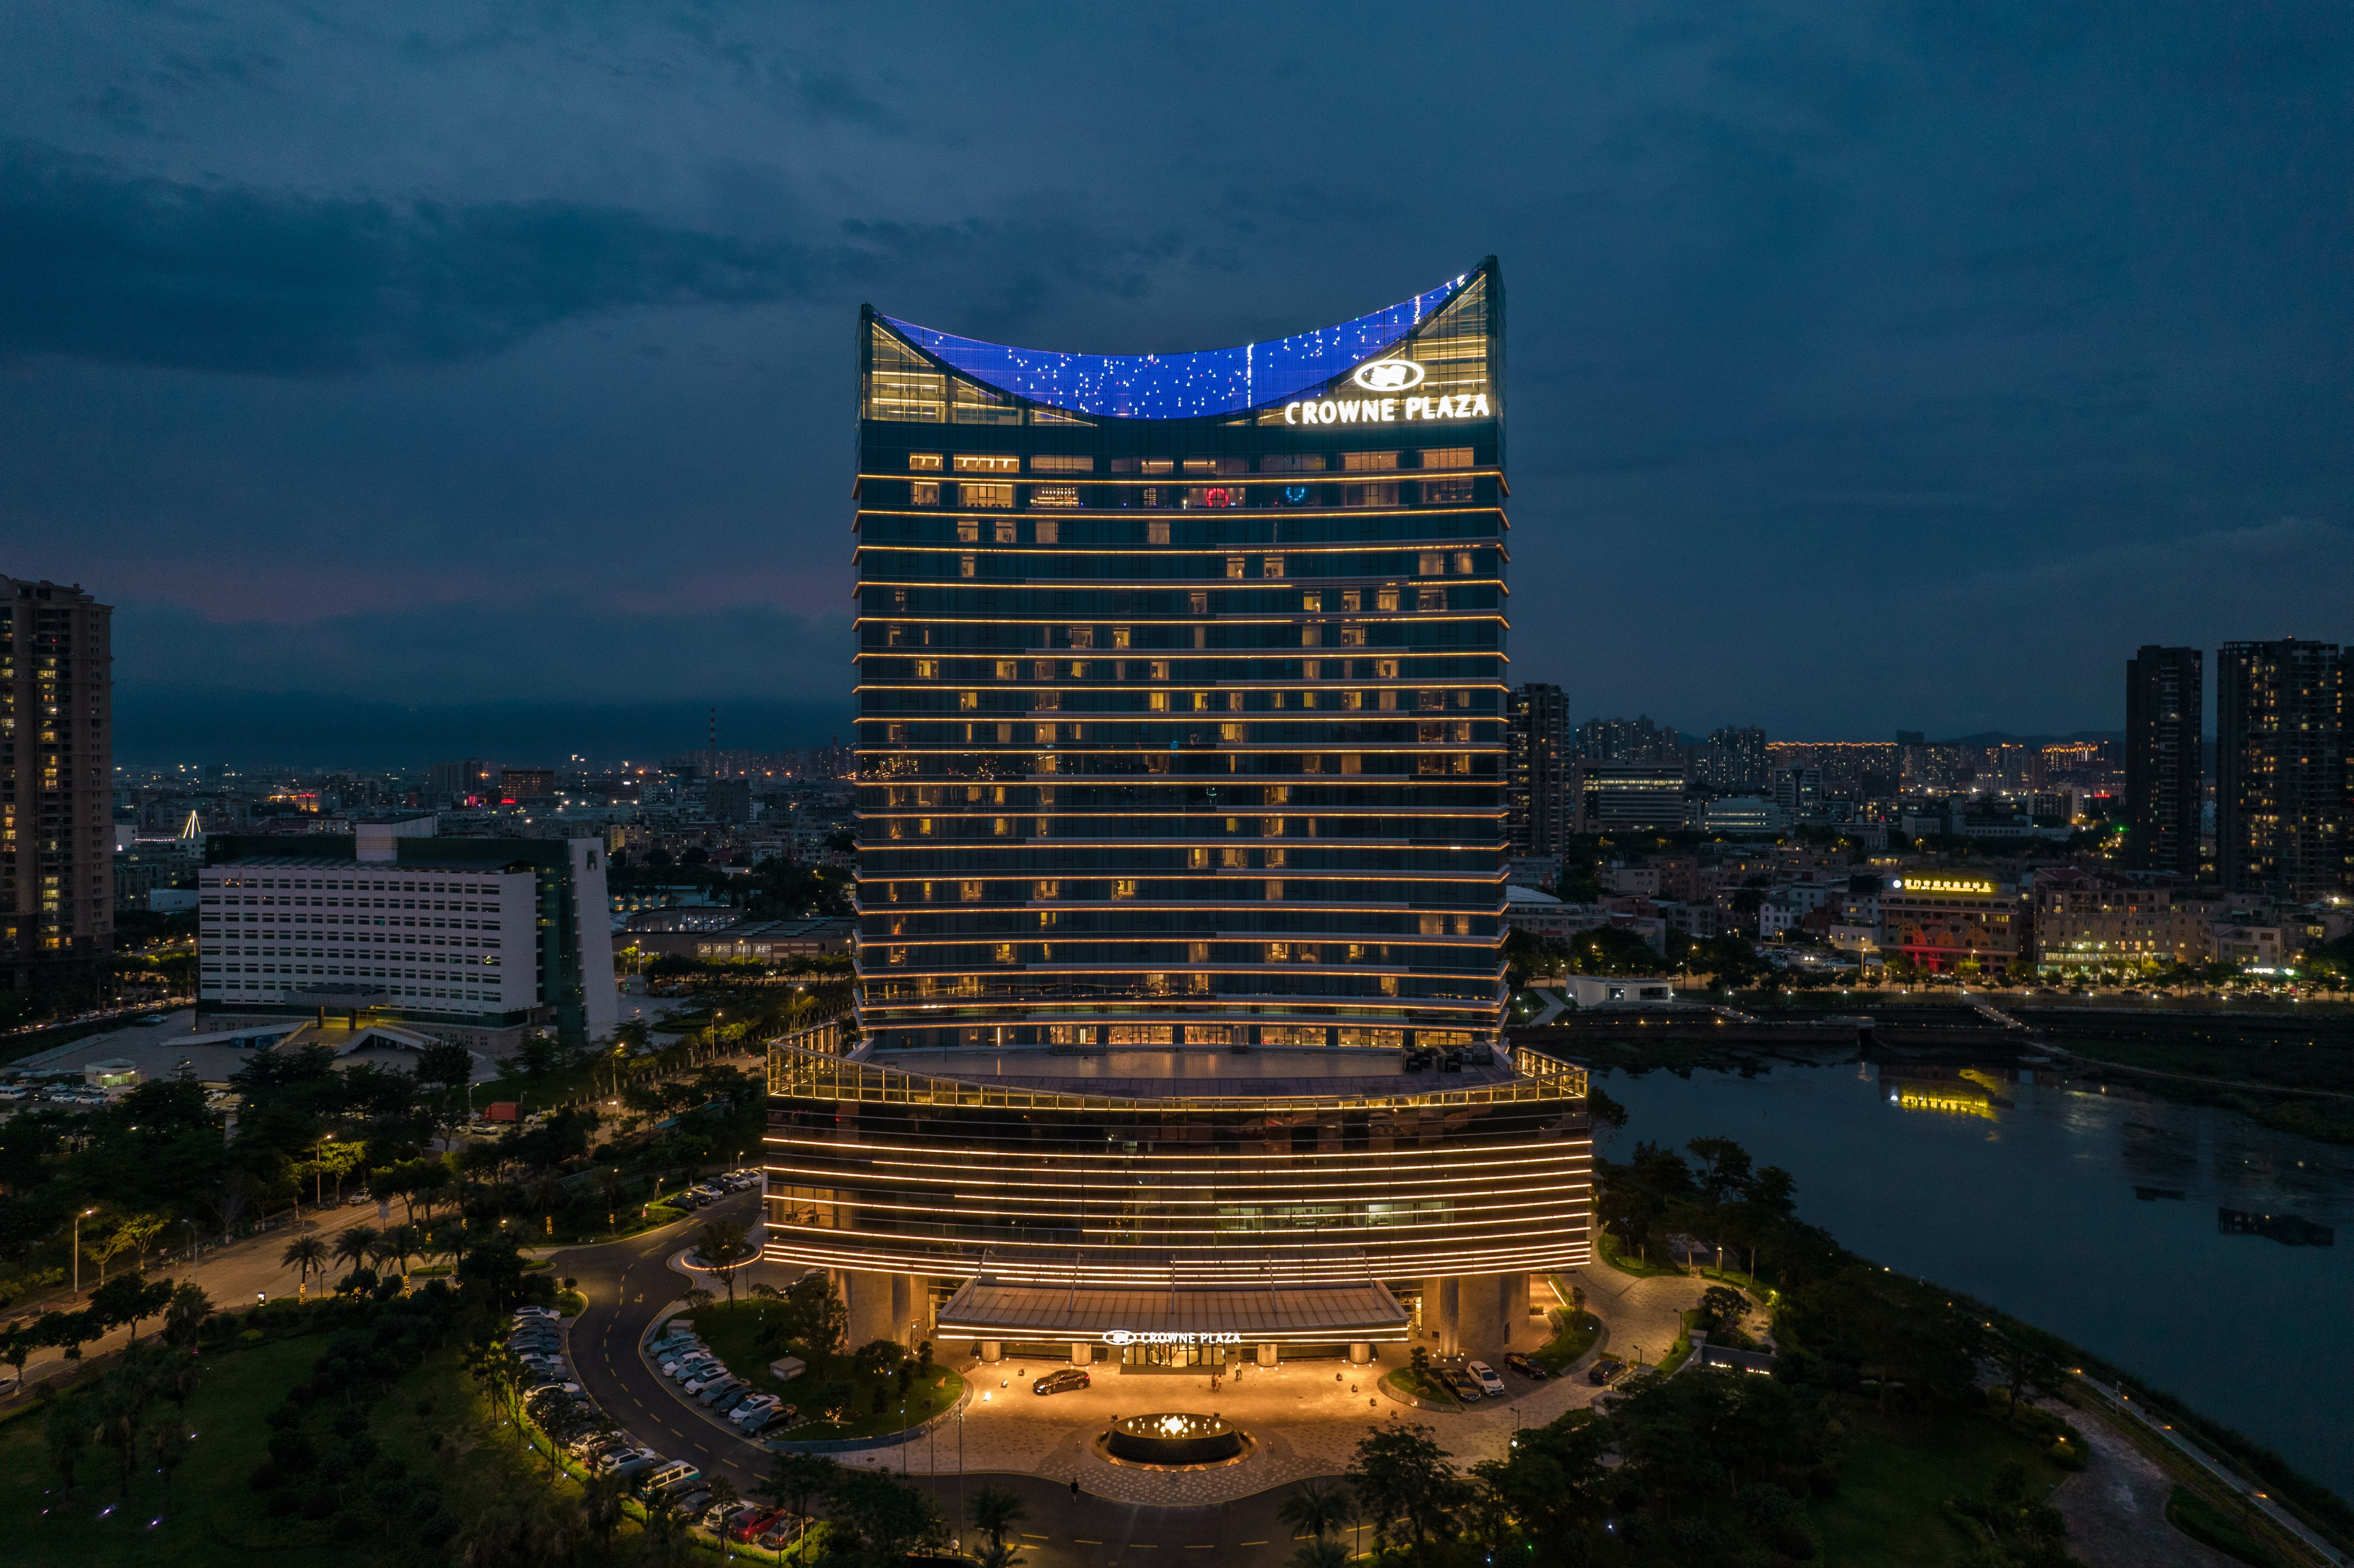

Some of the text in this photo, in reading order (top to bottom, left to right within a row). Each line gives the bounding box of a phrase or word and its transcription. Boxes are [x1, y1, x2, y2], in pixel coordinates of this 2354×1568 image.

[1285, 394, 1489, 425] CROWNE PLAZA
[1141, 1332, 1241, 1343] CROWNE PLAZA
